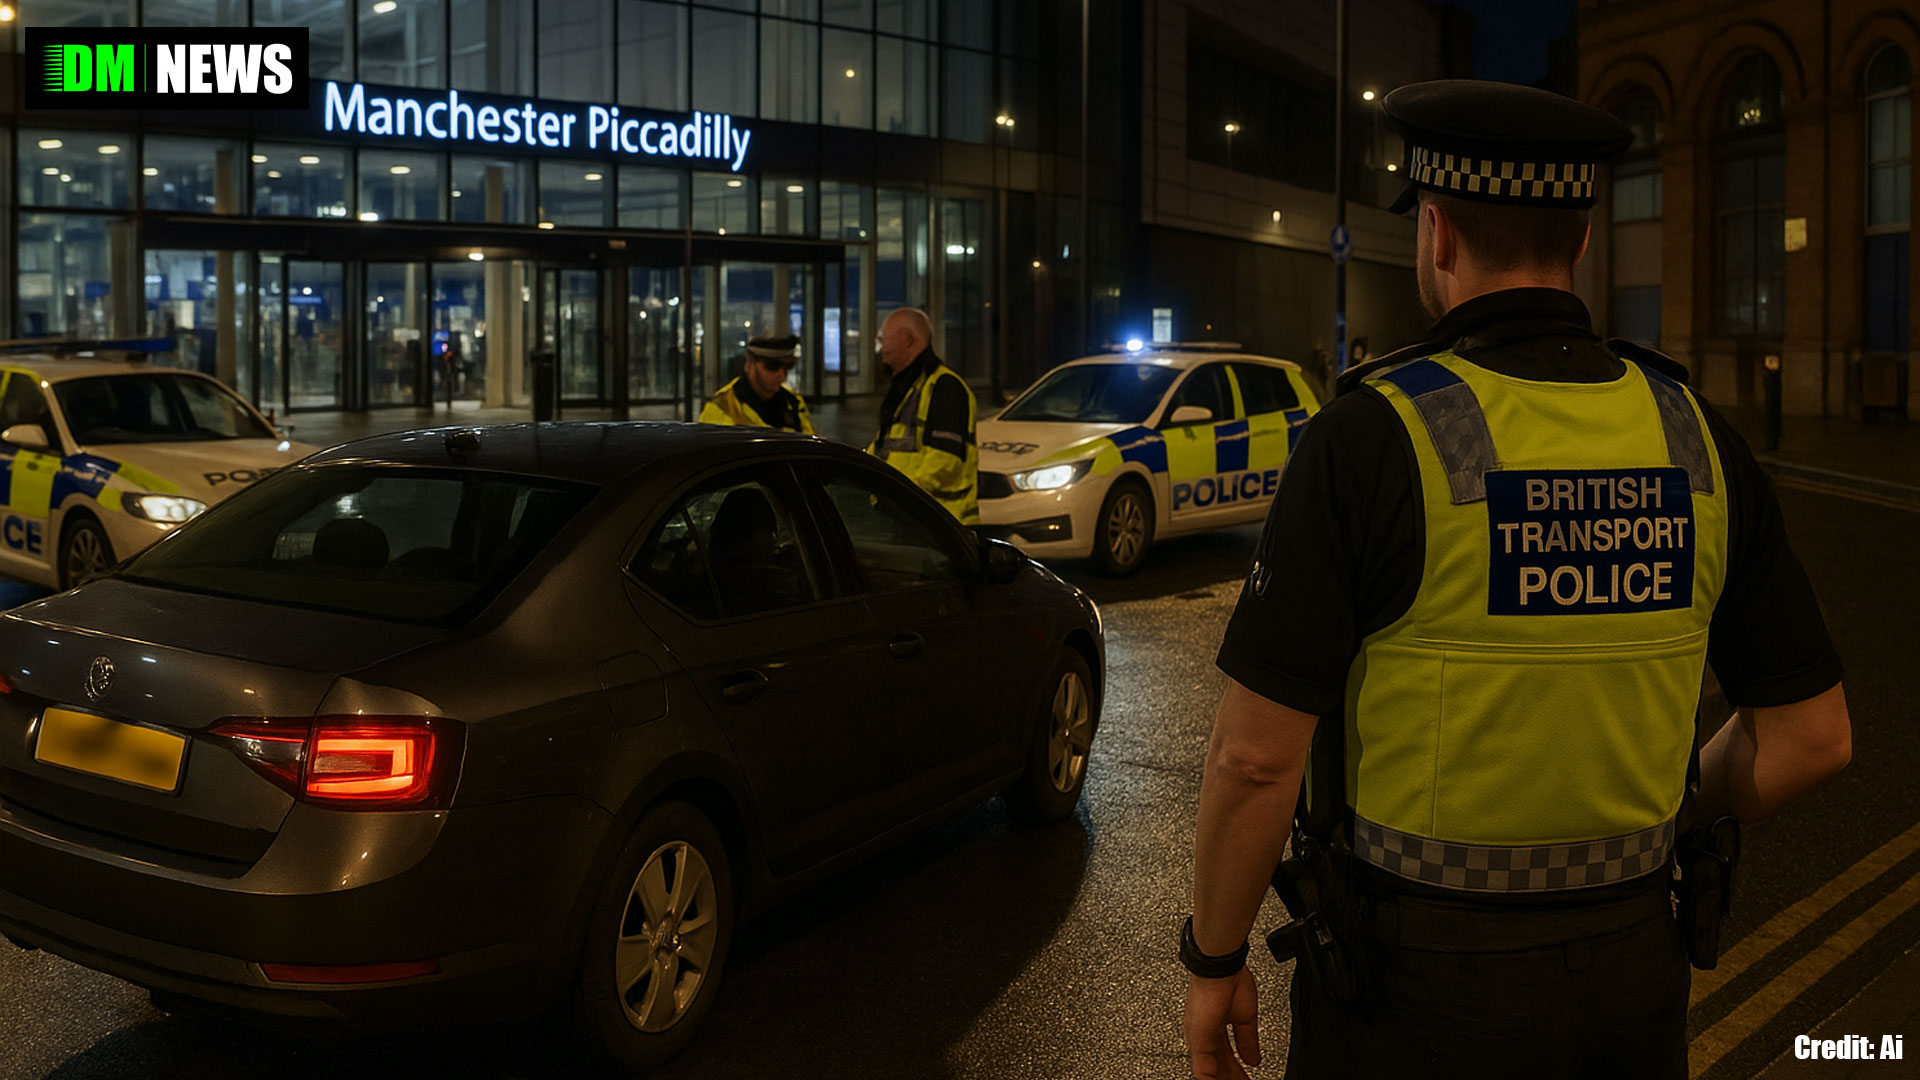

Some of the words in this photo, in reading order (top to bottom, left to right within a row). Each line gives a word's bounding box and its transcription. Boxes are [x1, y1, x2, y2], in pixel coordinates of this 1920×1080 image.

[324, 80, 576, 149] Manchester
[588, 105, 752, 172] Piccadilly
[1173, 469, 1278, 512] POLICE
[1525, 476, 1662, 511] BRITISH
[1497, 517, 1689, 554] TRANSPORT
[1519, 561, 1673, 606] POLICE
